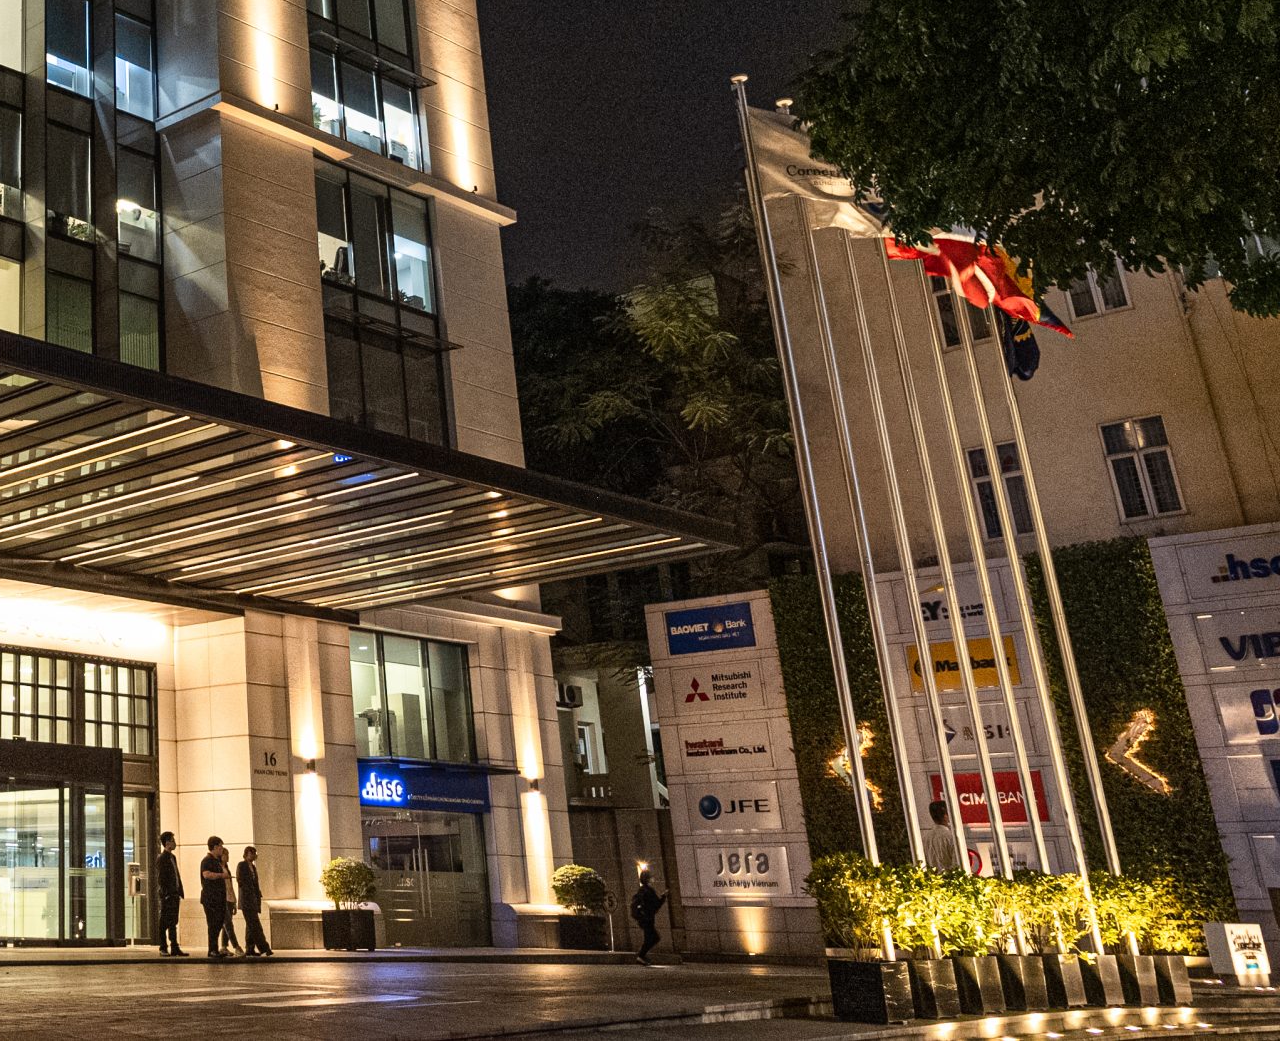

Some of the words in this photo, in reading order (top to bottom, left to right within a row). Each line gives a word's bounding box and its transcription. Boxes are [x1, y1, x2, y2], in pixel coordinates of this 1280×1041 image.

[670, 623, 709, 635] BAOVIET
[725, 619, 747, 629] Bank
[935, 656, 1011, 673] Maban
[711, 671, 752, 683] Mitsubishi
[712, 681, 748, 692] Research
[713, 691, 748, 701] Institute
[264, 752, 276, 766] 16
[725, 799, 771, 813] JFE
[960, 792, 989, 806] CIM
